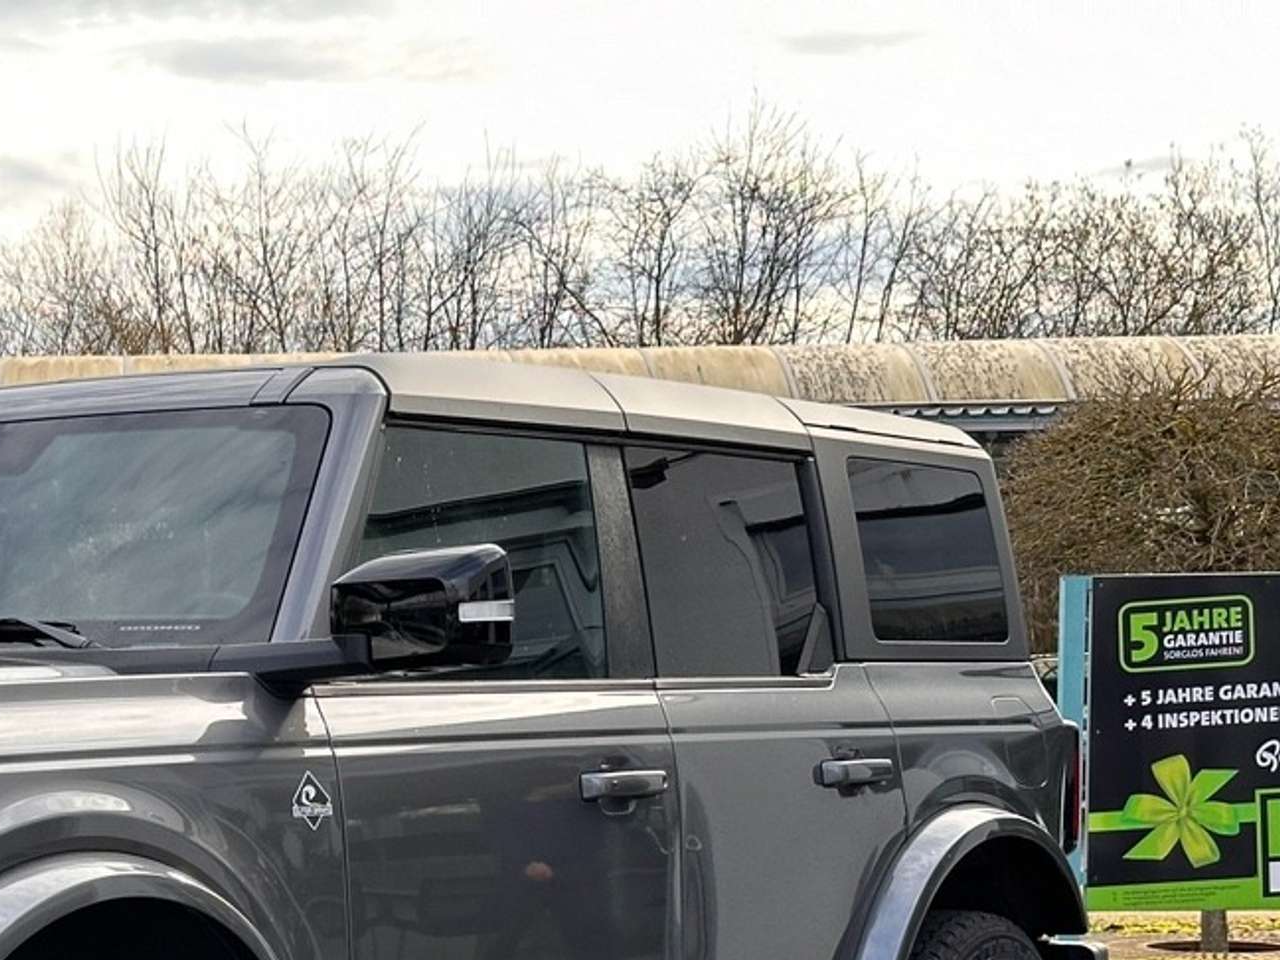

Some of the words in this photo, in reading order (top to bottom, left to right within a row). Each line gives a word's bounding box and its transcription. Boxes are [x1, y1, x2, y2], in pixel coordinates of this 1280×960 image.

[1130, 612, 1159, 663] 5
[1162, 606, 1243, 633] JAHRE
[1163, 630, 1244, 649] GARANTIE
[1141, 690, 1152, 706] 5
[1156, 685, 1215, 705] JAHRE
[1141, 714, 1153, 730] 4
[1157, 706, 1280, 729] INSPEKTIONE
